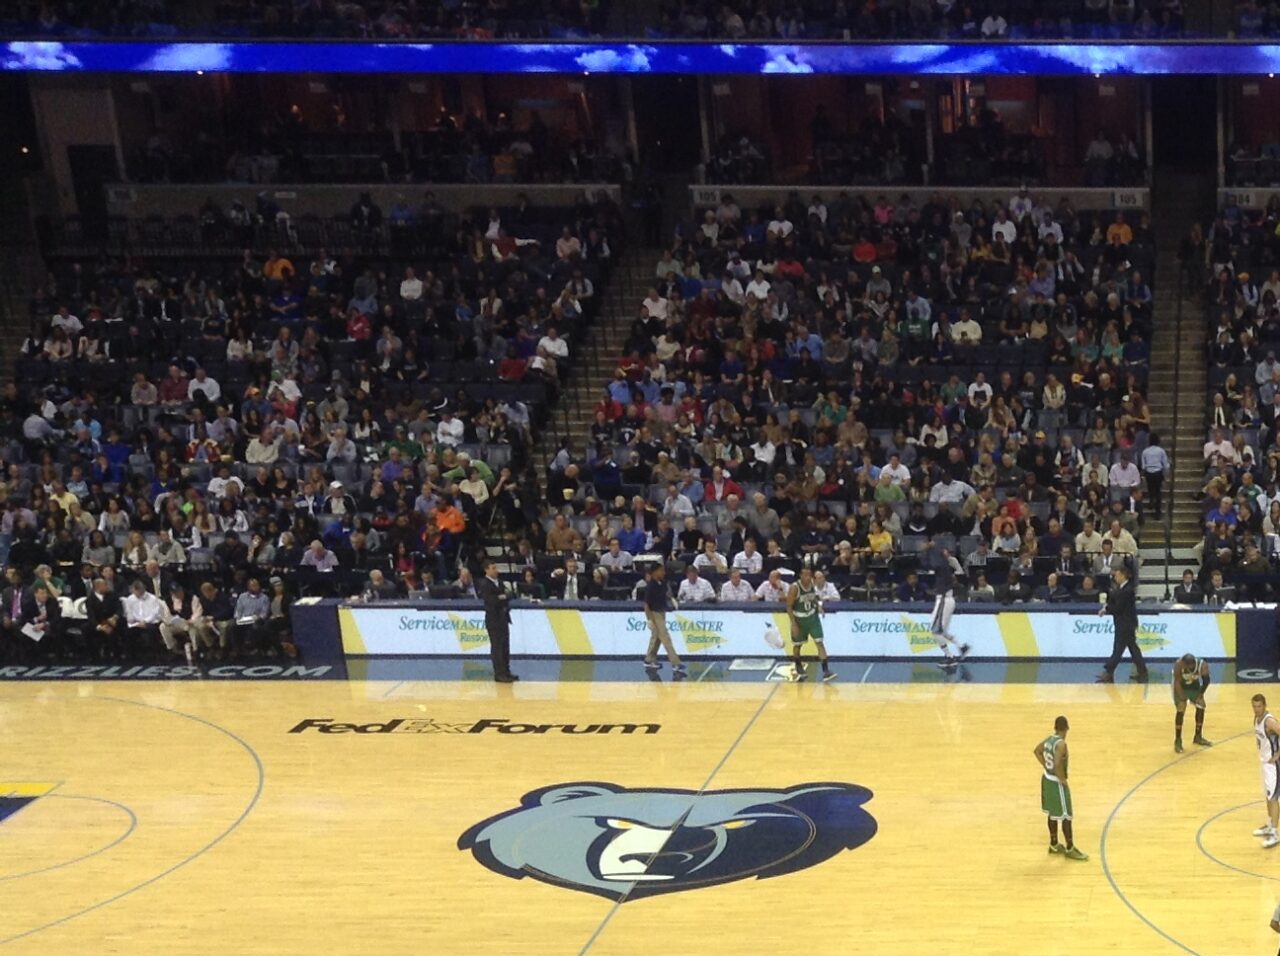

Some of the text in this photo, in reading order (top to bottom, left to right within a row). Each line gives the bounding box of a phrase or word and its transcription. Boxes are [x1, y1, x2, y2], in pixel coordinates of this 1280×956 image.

[399, 616, 486, 630] ServiceMAST
[851, 618, 931, 633] ServiceMAST
[288, 718, 662, 734] FedExForum
